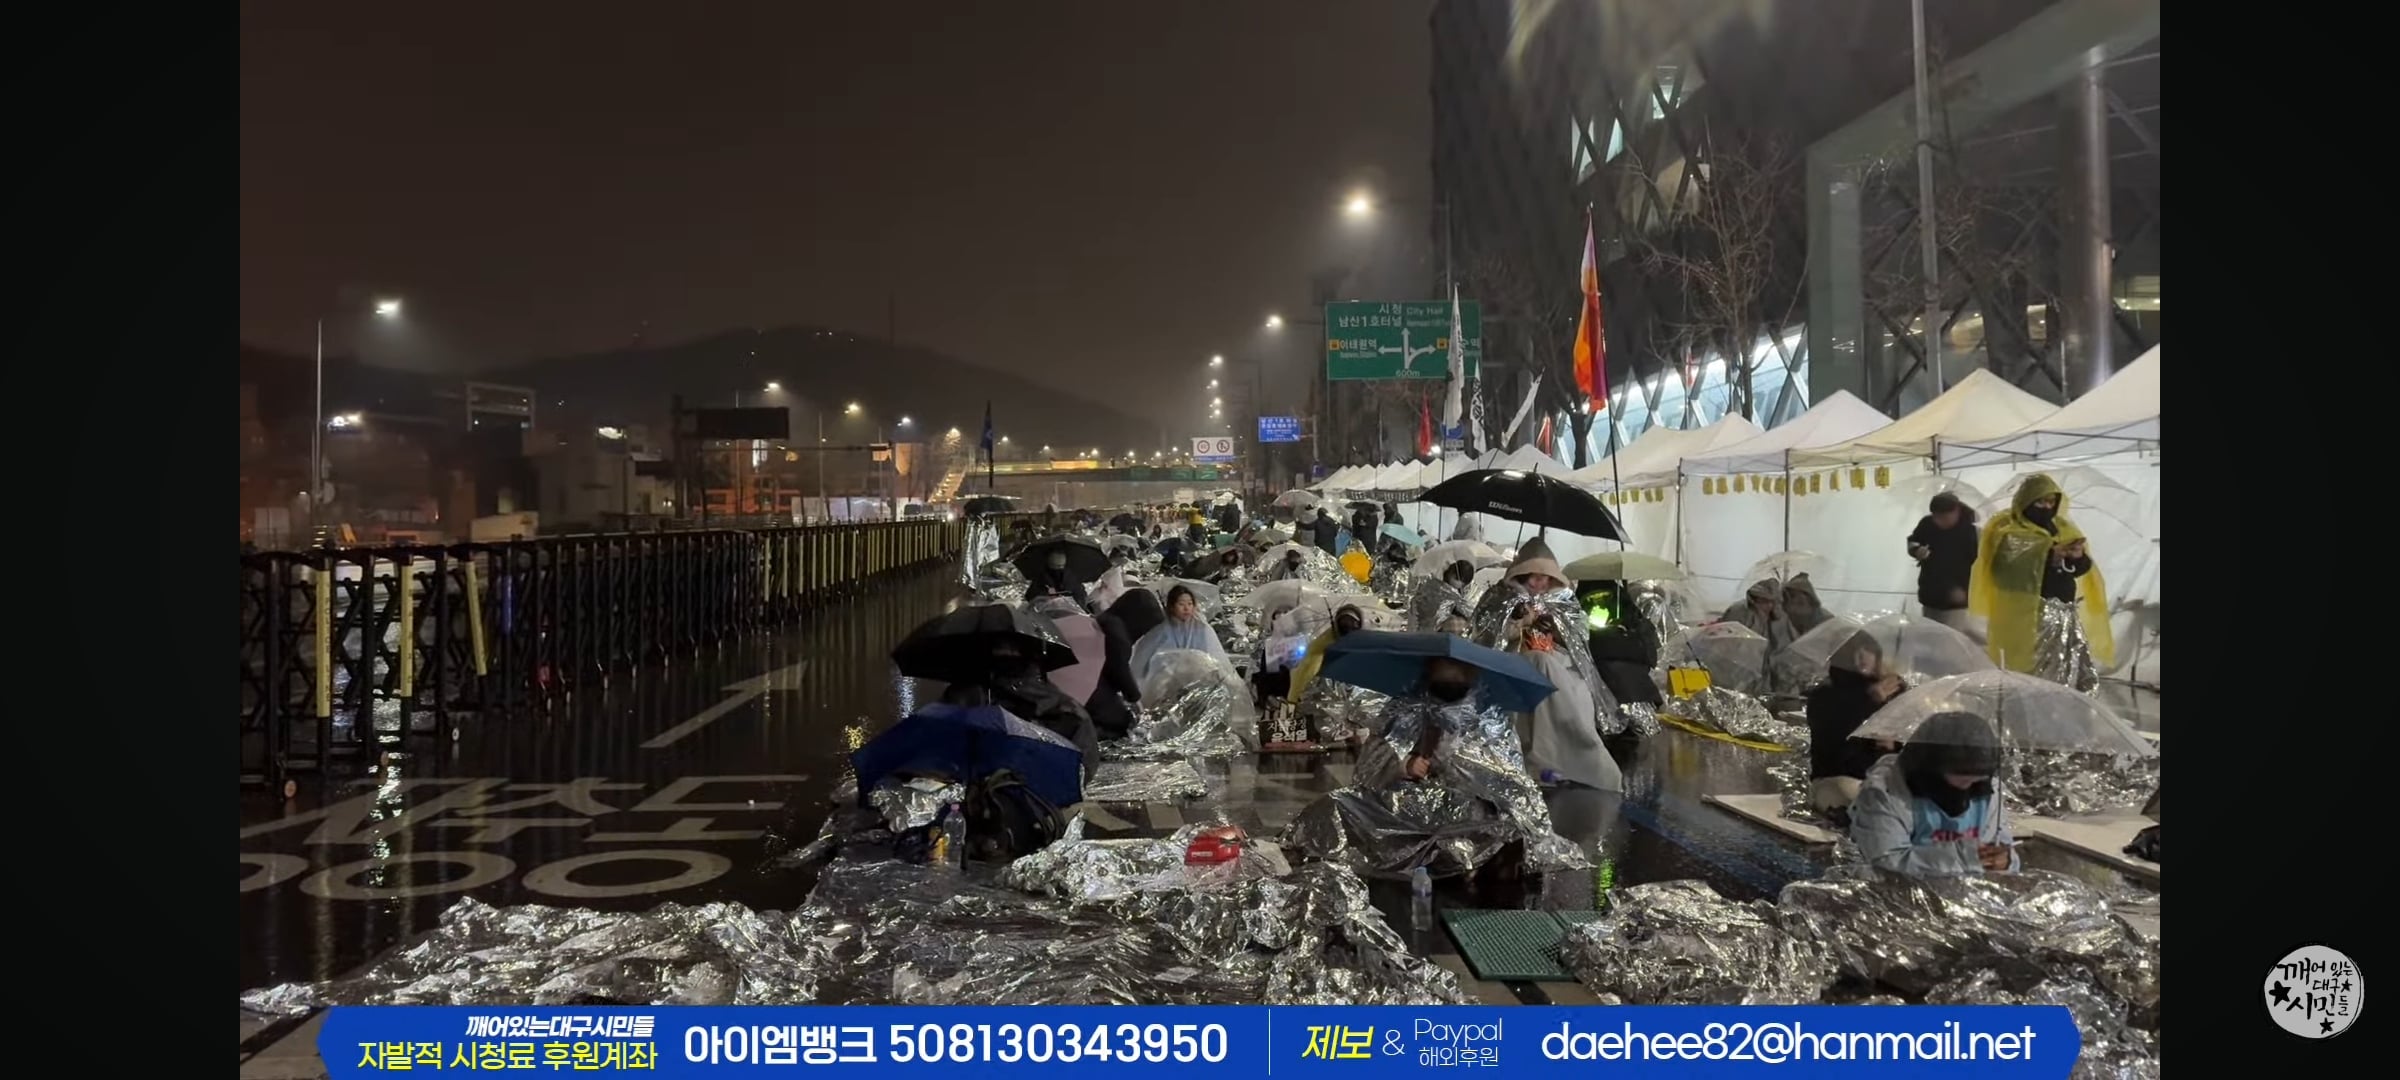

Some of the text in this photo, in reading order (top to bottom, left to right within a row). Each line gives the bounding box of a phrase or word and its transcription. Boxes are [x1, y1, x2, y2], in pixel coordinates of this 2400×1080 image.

[1379, 303, 1402, 315] 시청
[1339, 315, 1402, 328] 남산1호터널
[1340, 339, 1377, 350] 이태원역
